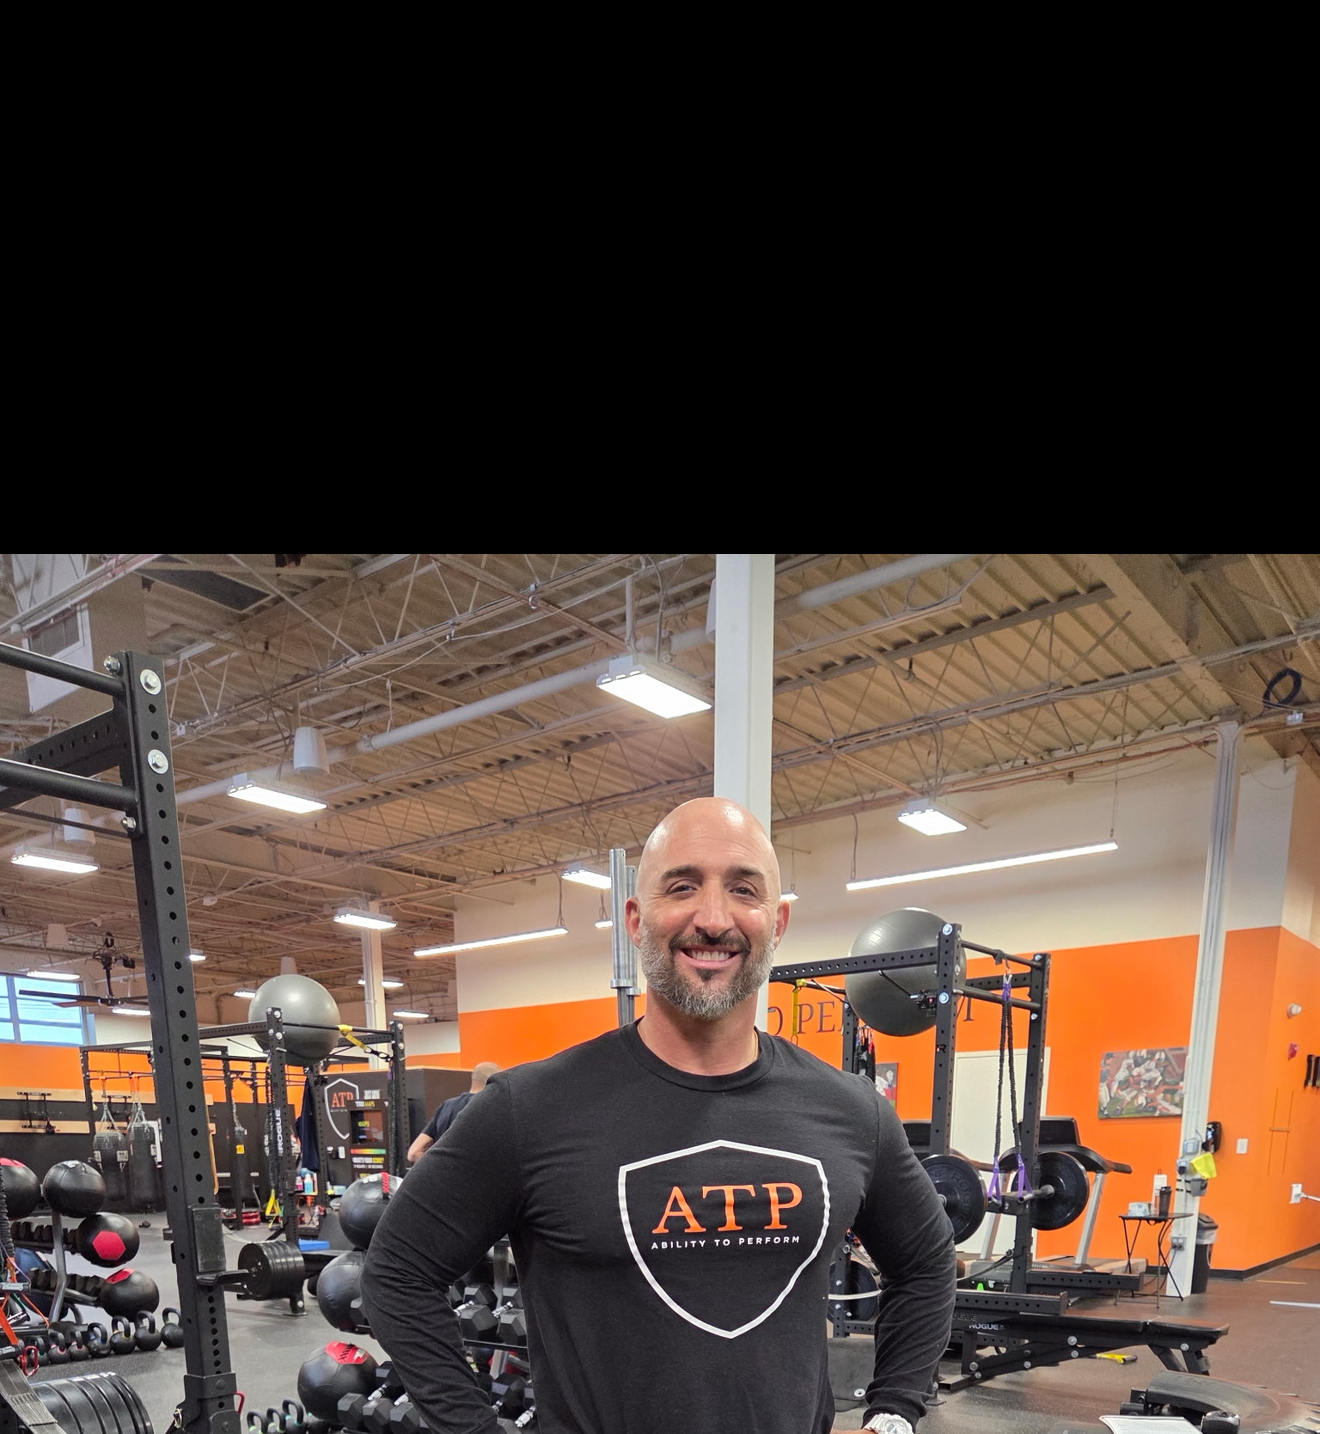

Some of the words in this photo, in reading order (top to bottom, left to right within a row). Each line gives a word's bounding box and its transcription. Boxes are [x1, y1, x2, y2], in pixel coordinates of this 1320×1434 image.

[652, 1182, 803, 1234] ATP
[651, 1239, 706, 1250] ABILITY
[714, 1238, 731, 1247] TO
[738, 1235, 800, 1246] PERFORM
